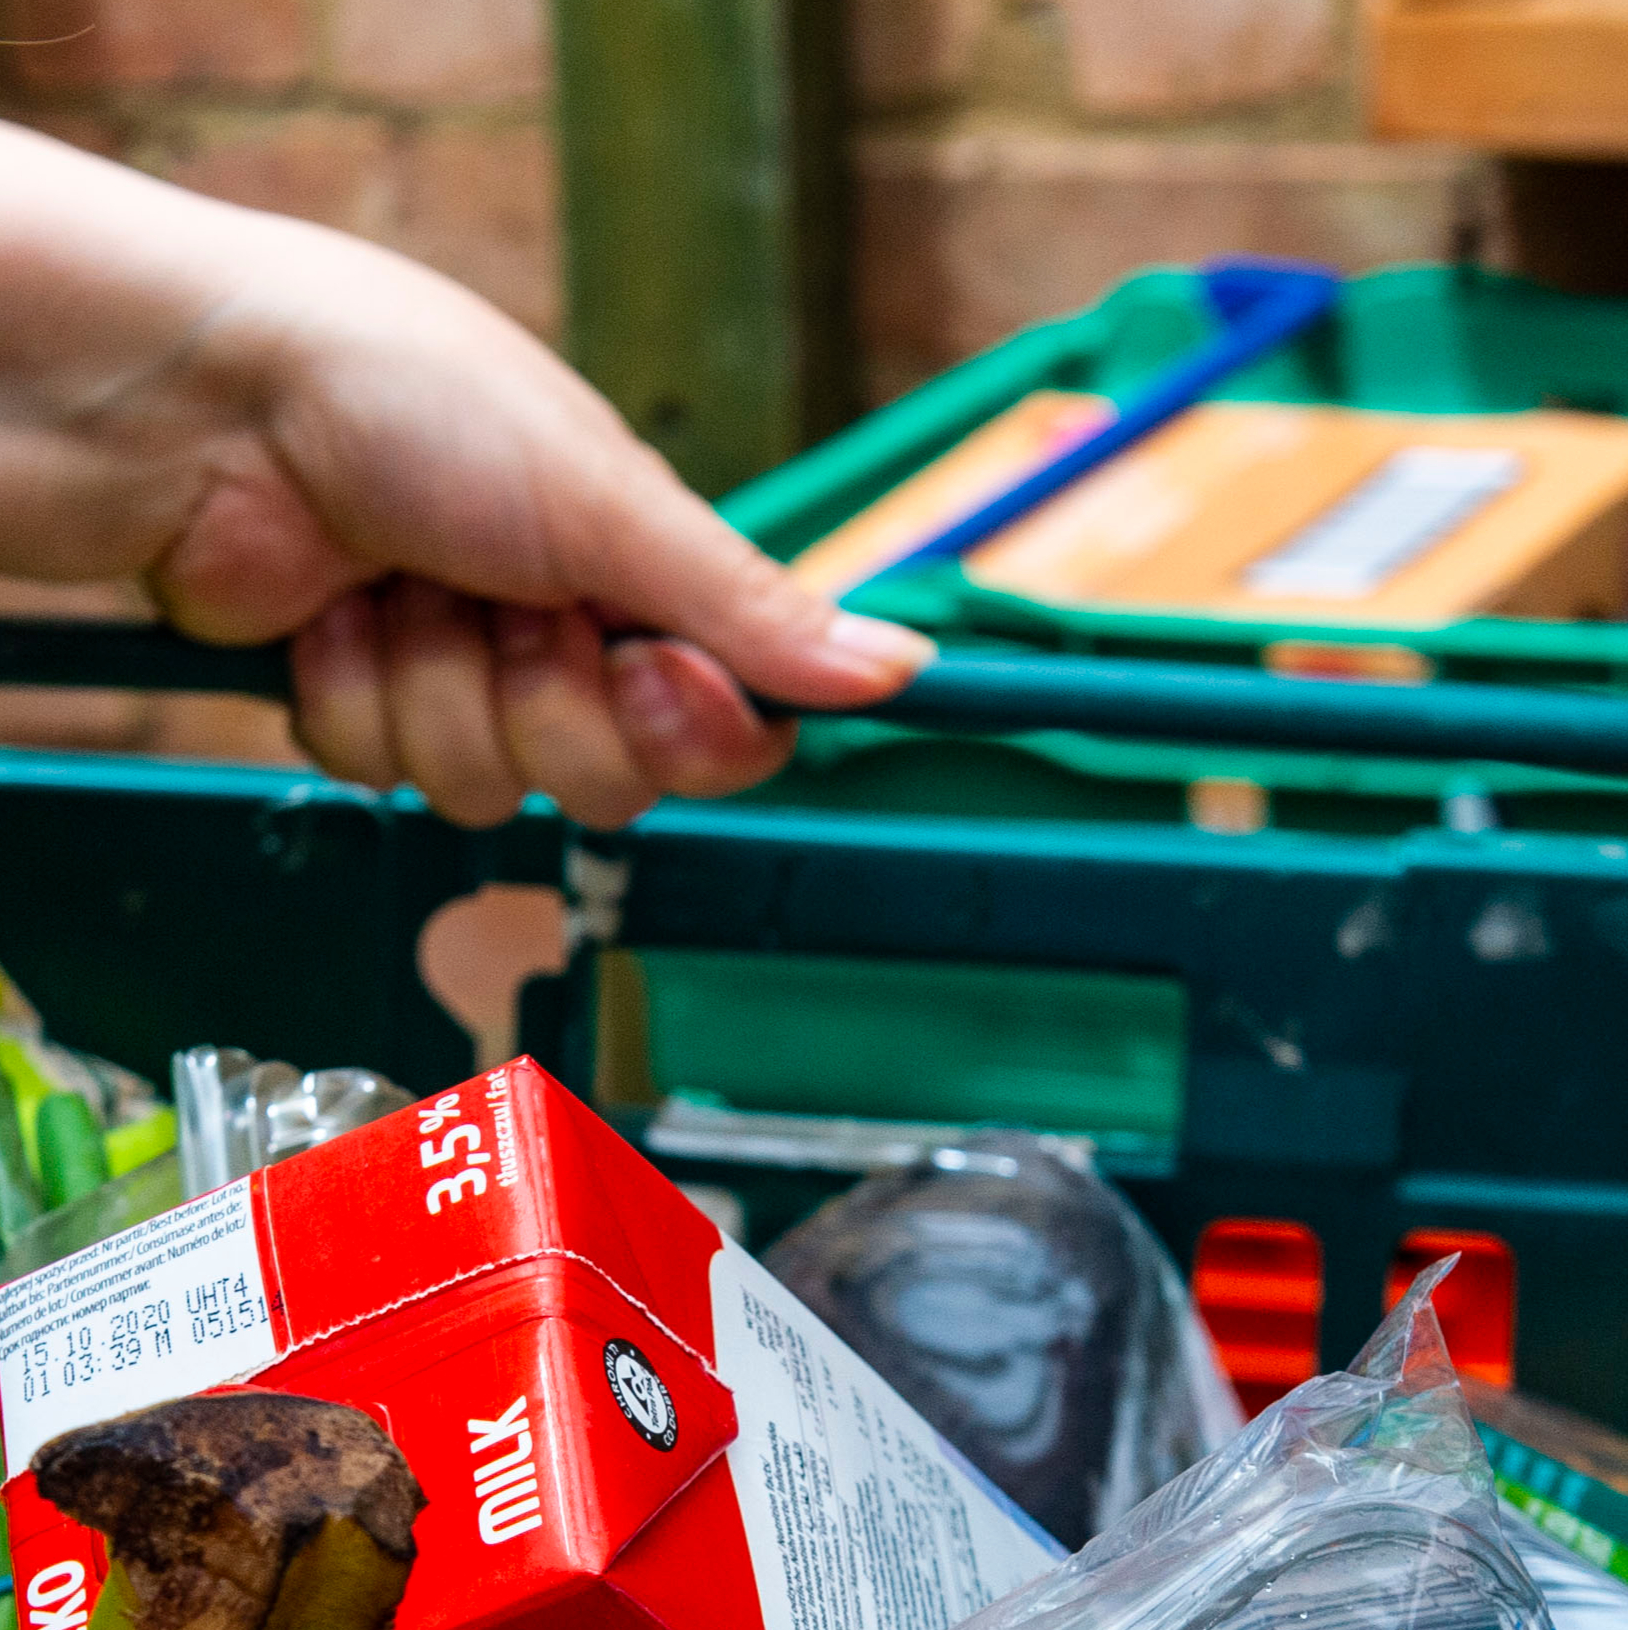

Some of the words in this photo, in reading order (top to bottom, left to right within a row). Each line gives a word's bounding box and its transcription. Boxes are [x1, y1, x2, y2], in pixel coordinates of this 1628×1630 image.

[485, 1068, 507, 1099] fat
[418, 1093, 492, 1216] 3,5%
[185, 1271, 248, 1315] UHT4
[23, 1369, 51, 1404] 01
[154, 1327, 172, 1358] M
[468, 1396, 542, 1545] MILK
